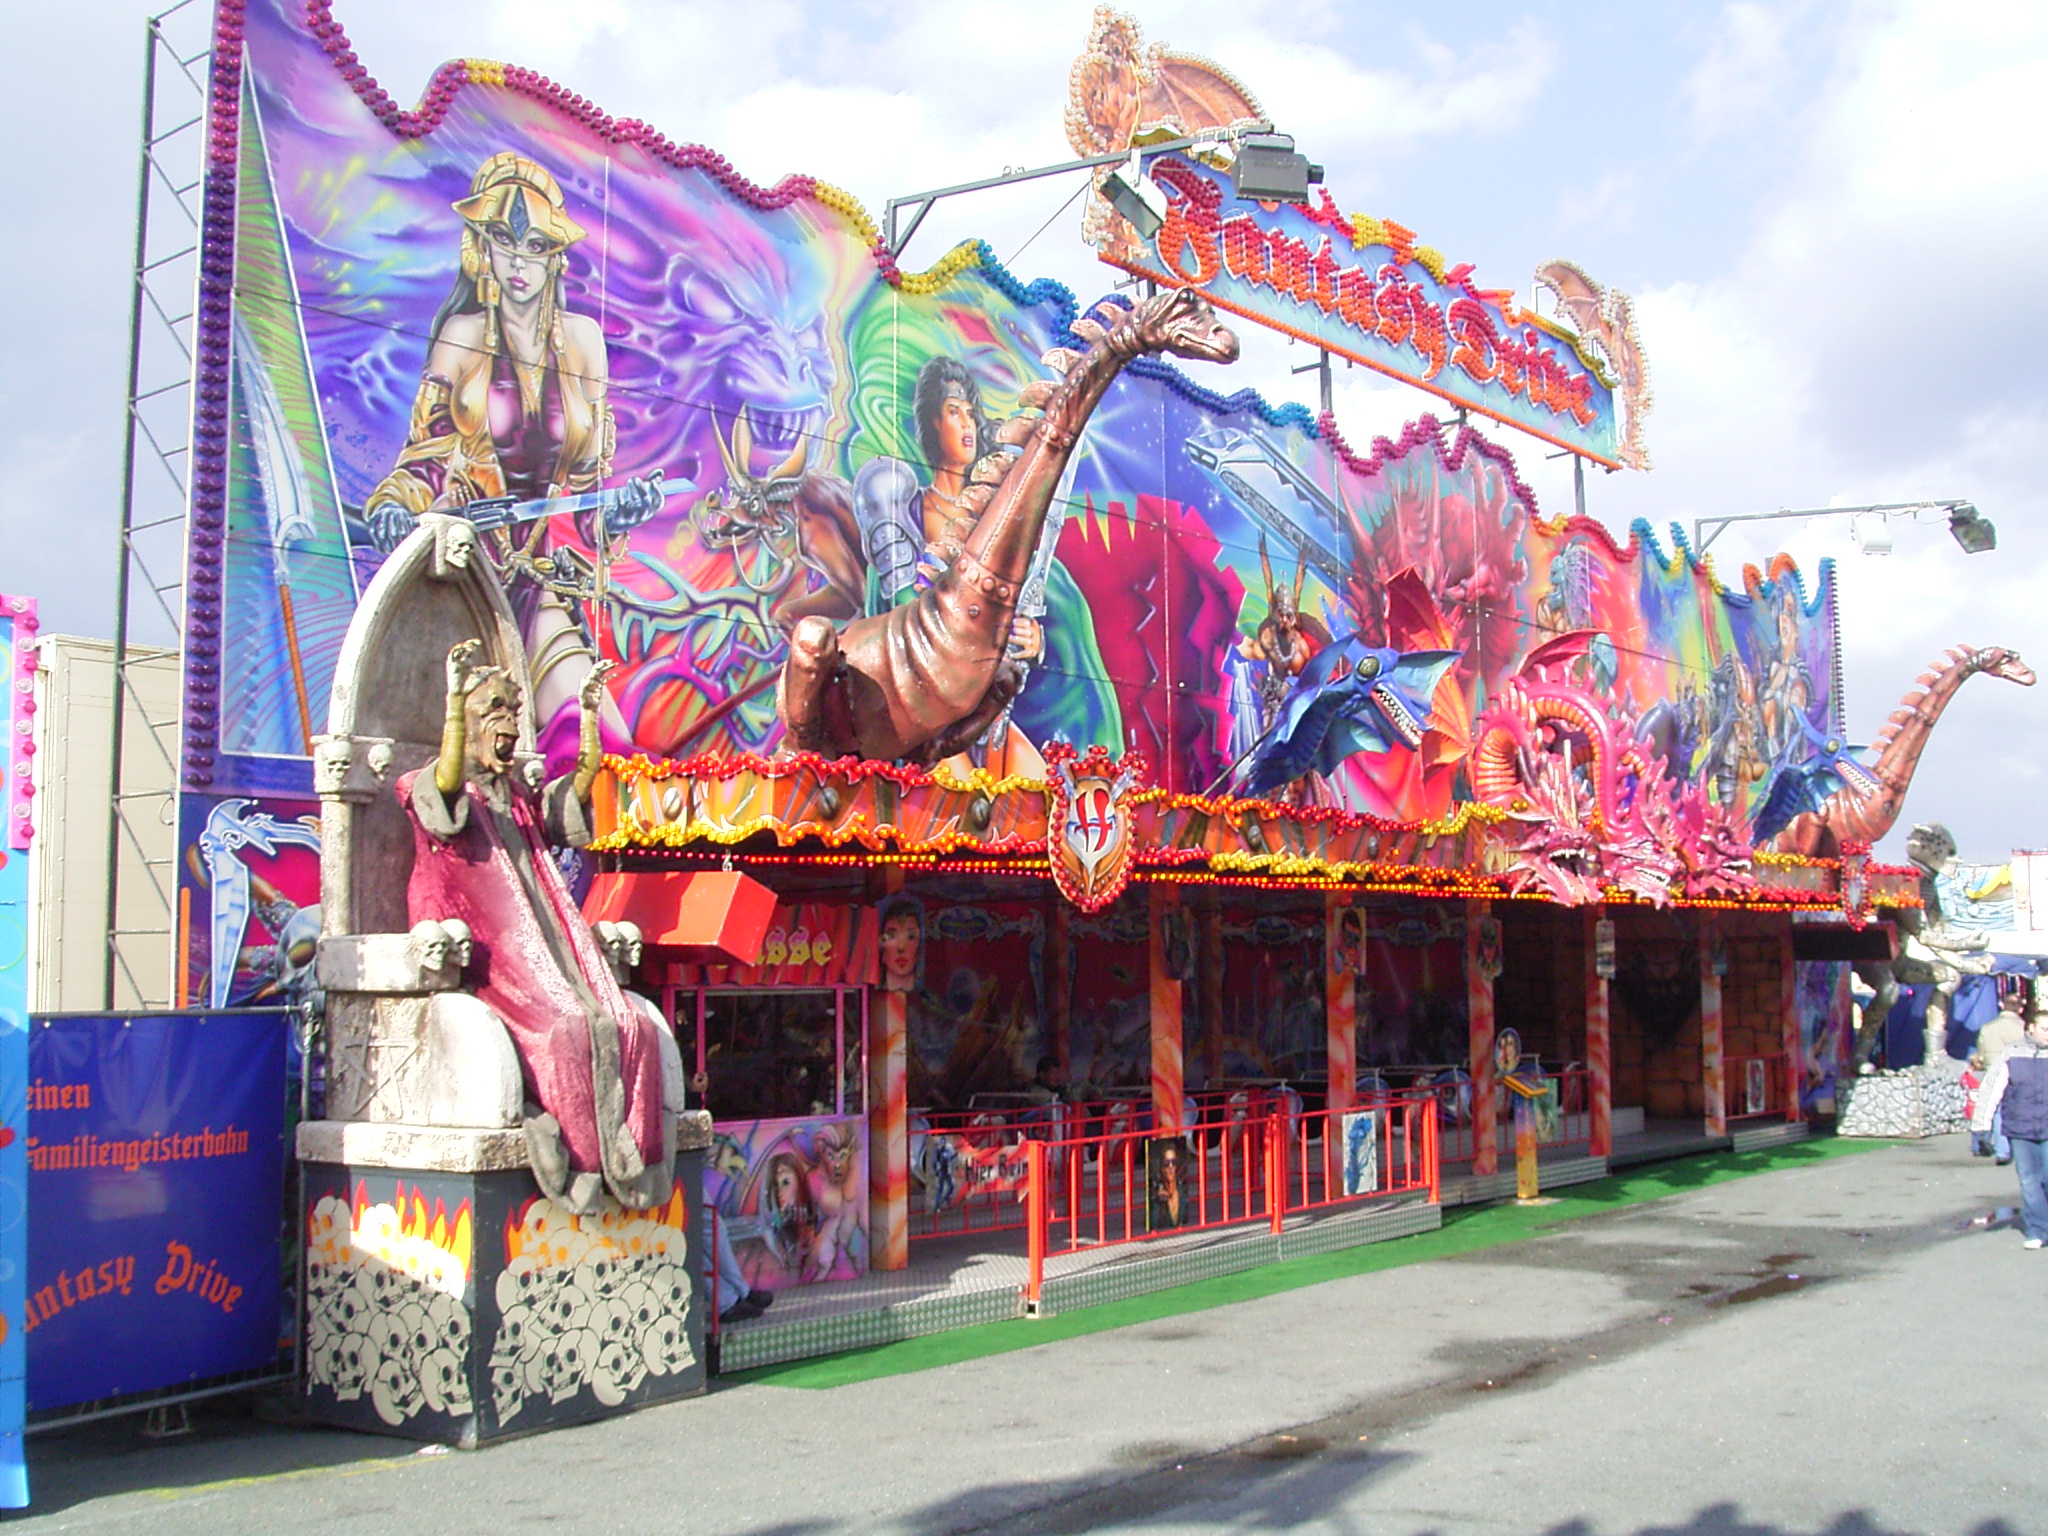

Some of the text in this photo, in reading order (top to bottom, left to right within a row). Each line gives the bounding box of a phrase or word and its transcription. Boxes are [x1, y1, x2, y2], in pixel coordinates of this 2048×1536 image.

[1148, 156, 1597, 428] Fantasy Drive
[155, 1239, 243, 1313] Drive
